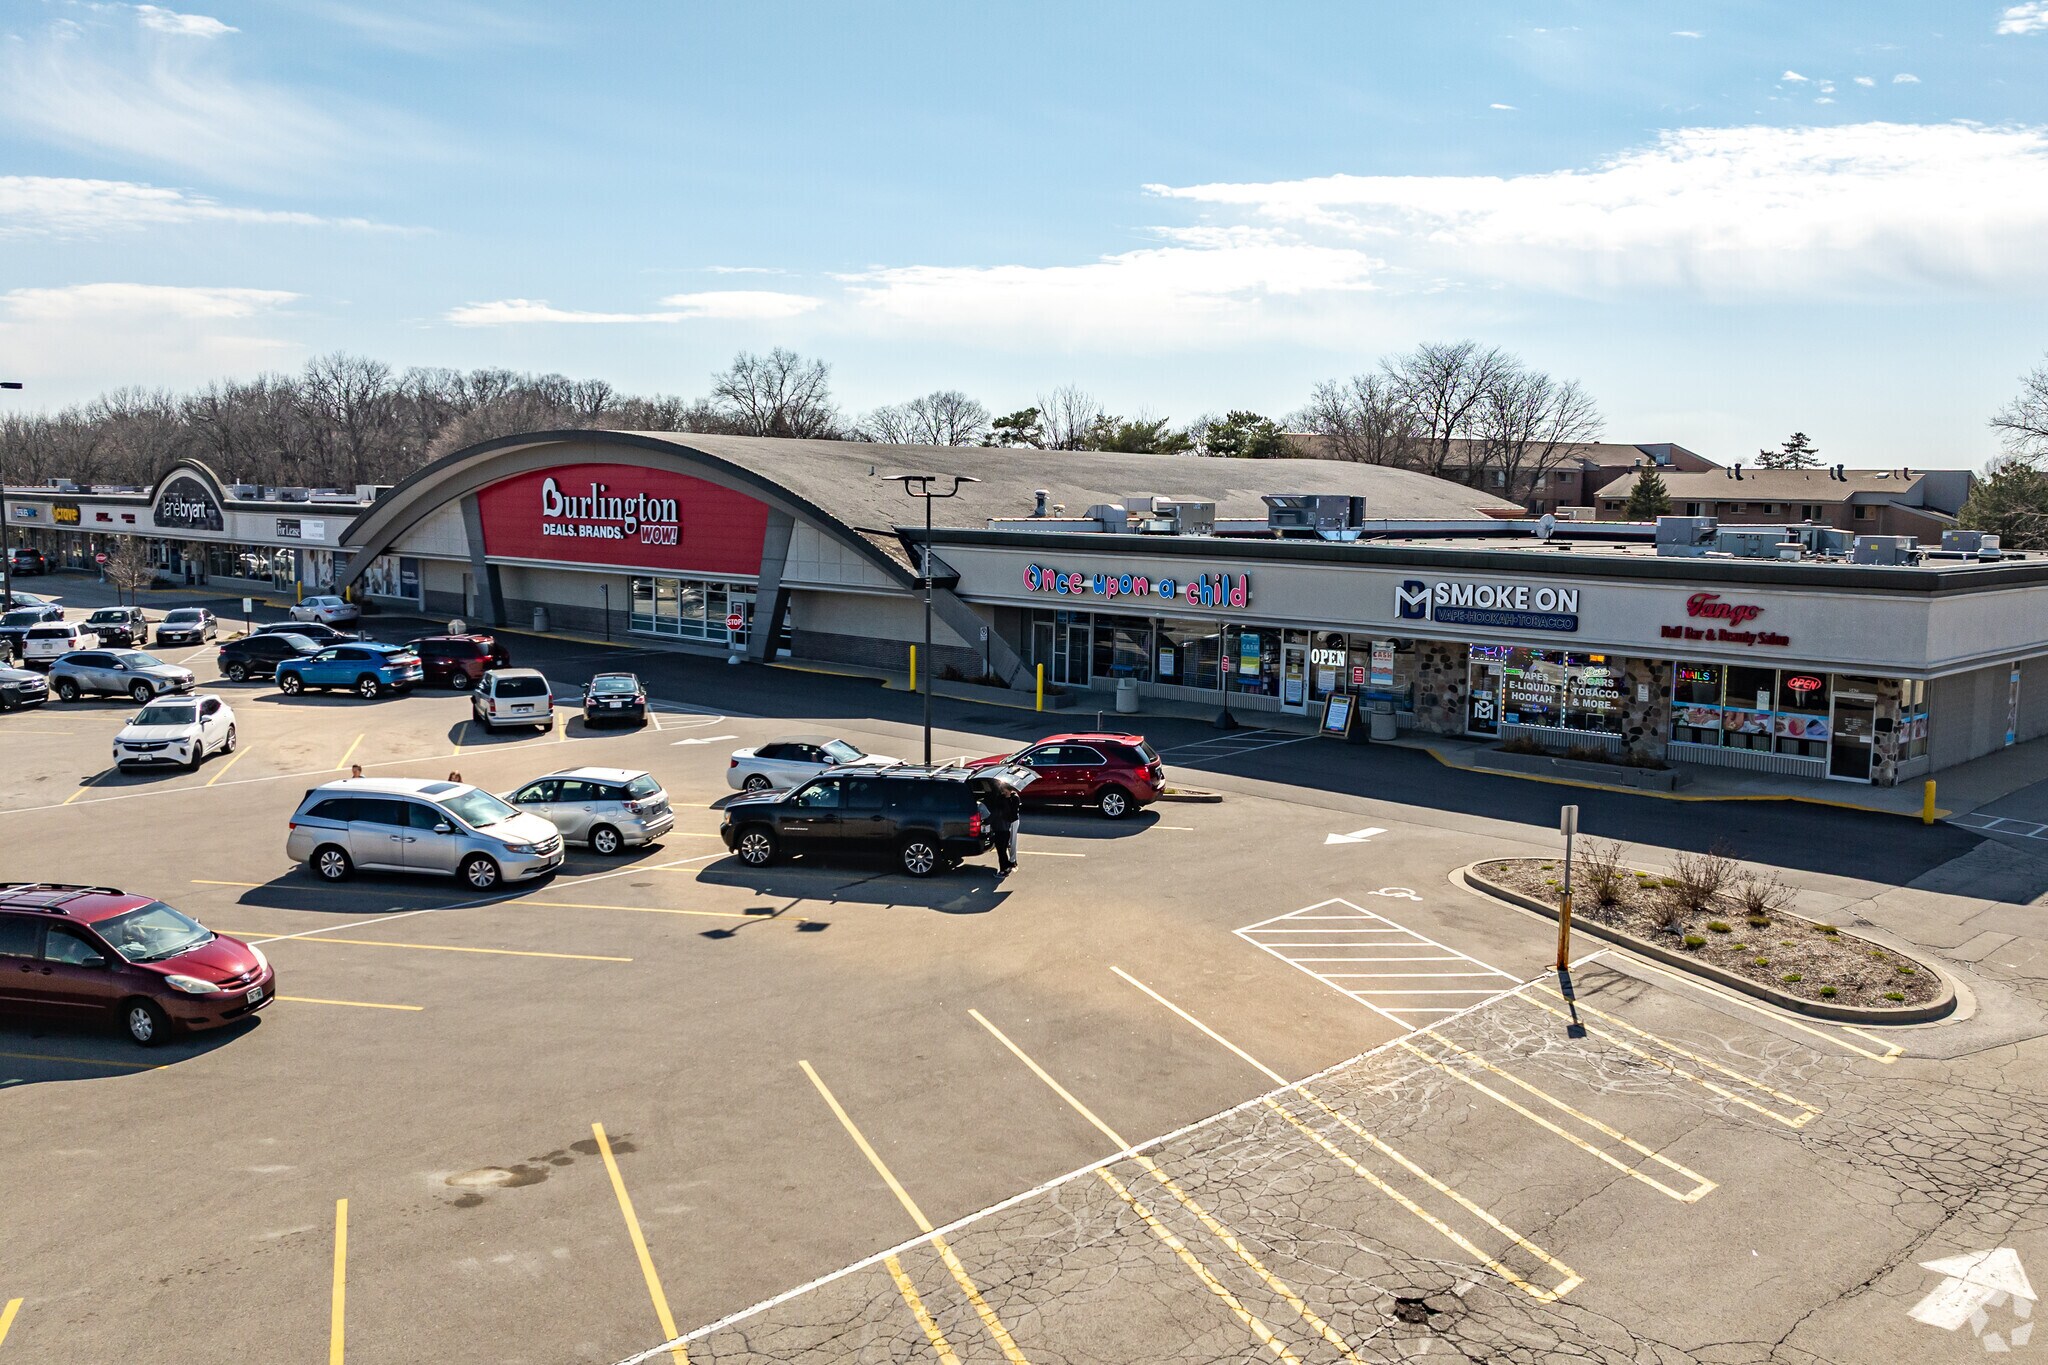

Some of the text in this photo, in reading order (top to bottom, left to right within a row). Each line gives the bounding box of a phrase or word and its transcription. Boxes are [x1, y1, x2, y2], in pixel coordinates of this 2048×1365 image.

[542, 477, 679, 535] Burlington
[543, 523, 679, 546] DEALS. BRANDS. WOW!
[1023, 564, 1248, 609] Once upon a child
[1435, 582, 1579, 613] SMOKE ON
[1687, 593, 1765, 627] Tango
[727, 618, 743, 626] STOP
[1705, 628, 1717, 641] &
[1311, 648, 1346, 667] OPEN
[1373, 651, 1392, 660] CASH
[1519, 671, 1549, 682] VAPES
[1681, 670, 1710, 681] NAILS
[1509, 681, 1556, 694] E-LIQUIDS
[1791, 678, 1818, 690] OPEN
[1511, 692, 1552, 704] HOOKAH
[1572, 687, 1619, 700] TOBACCO
[1572, 698, 1580, 708] &
